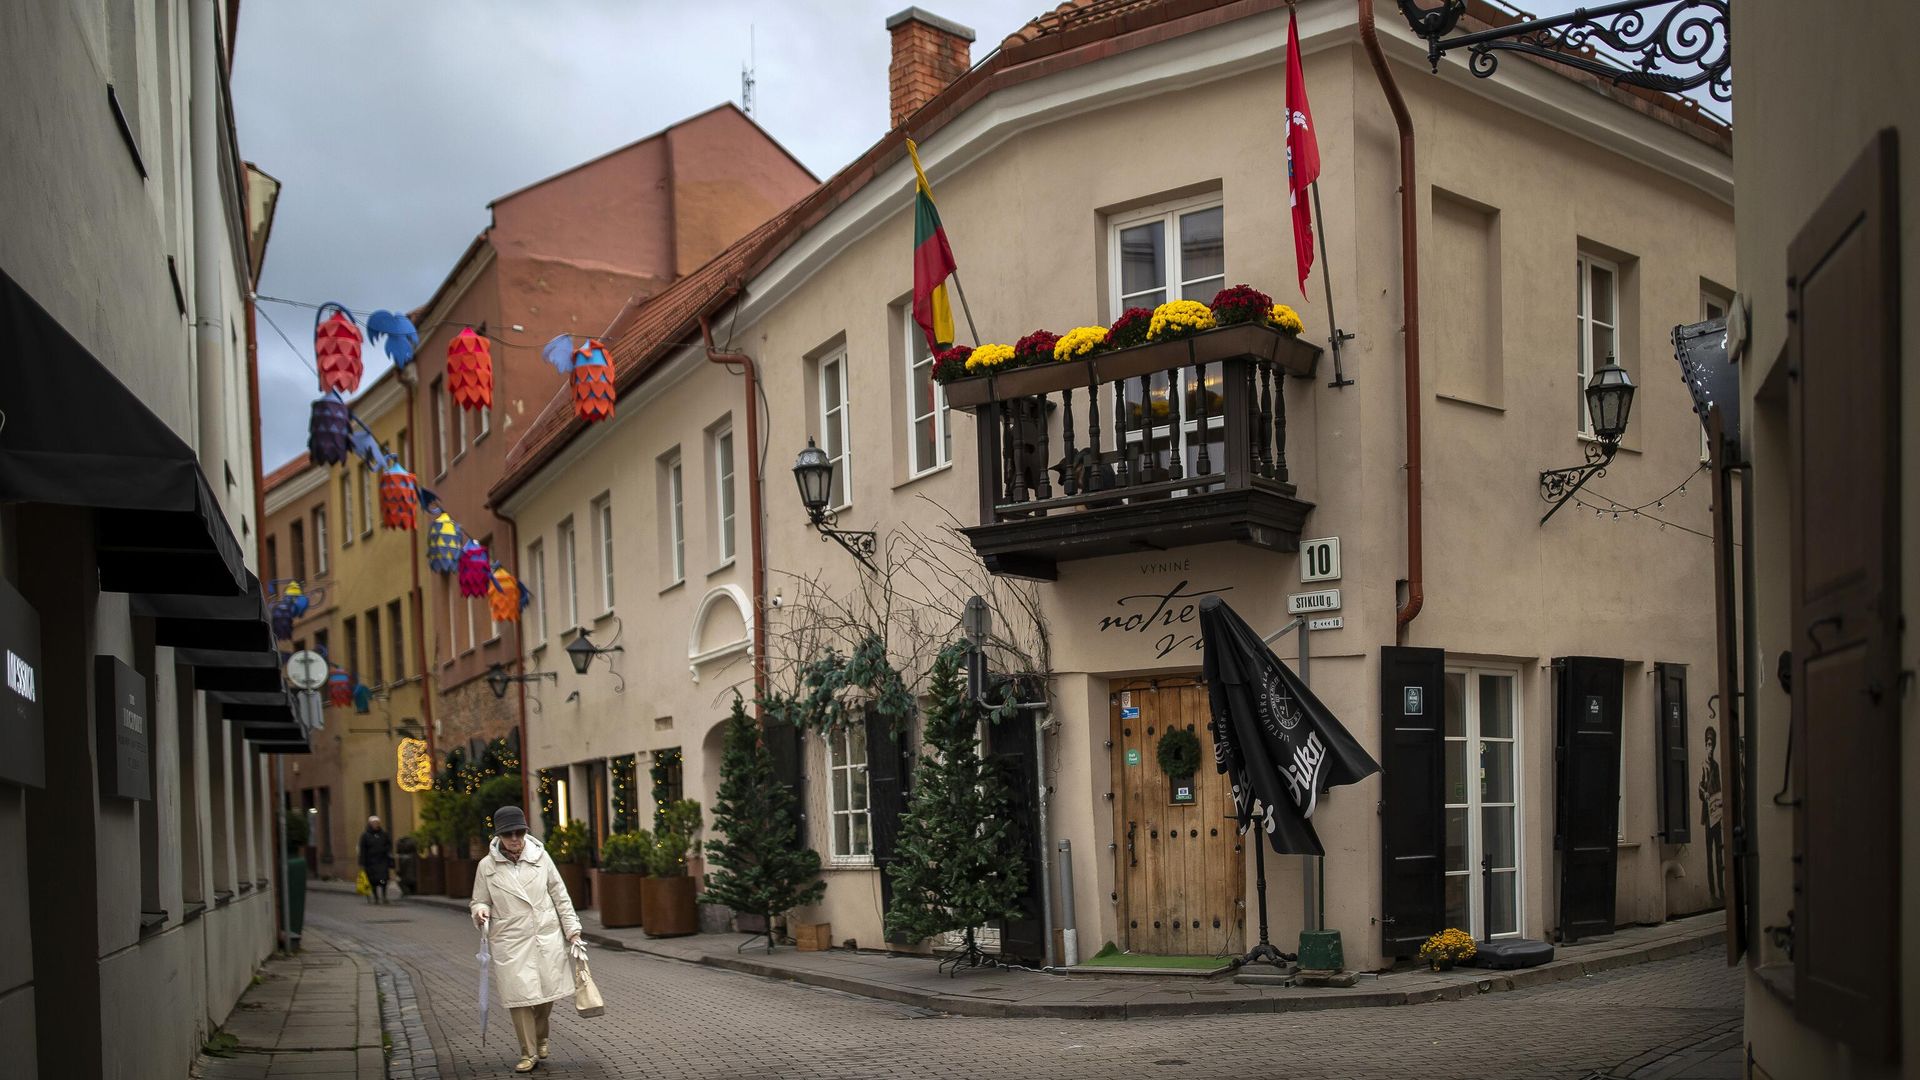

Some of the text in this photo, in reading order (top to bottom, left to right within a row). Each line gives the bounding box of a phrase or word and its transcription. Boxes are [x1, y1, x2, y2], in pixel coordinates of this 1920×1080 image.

[1140, 558, 1191, 575] VYNINĖ
[1307, 544, 1330, 576] 10
[1332, 619, 1340, 627] 10
